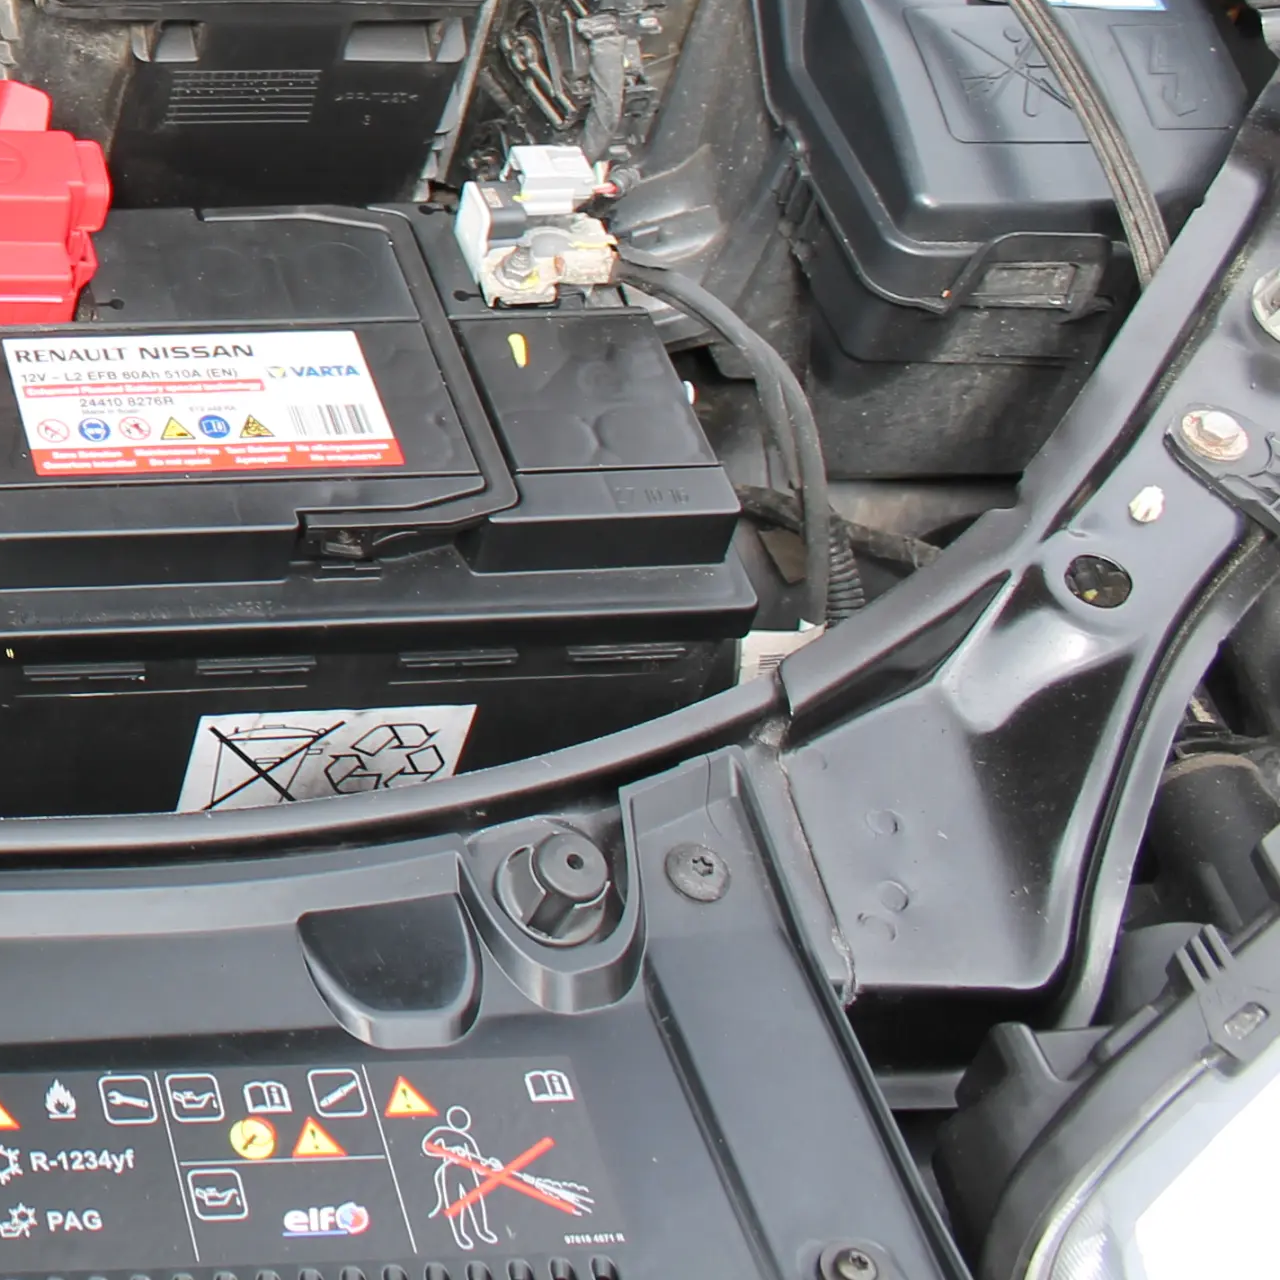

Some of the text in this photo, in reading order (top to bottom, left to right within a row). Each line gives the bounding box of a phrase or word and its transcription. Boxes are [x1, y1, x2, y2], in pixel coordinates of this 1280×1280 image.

[14, 343, 255, 364] RENAULT NISSAN
[21, 372, 46, 383] 12V
[64, 371, 82, 382] L2
[87, 370, 118, 381] EFB
[164, 368, 202, 379] 510A
[206, 367, 239, 380] (EN)
[291, 364, 360, 379] VARTA
[79, 397, 123, 408] 24410
[29, 1148, 135, 1174] R-1234yf
[46, 1210, 103, 1232] PAG
[283, 1205, 340, 1233] elf
